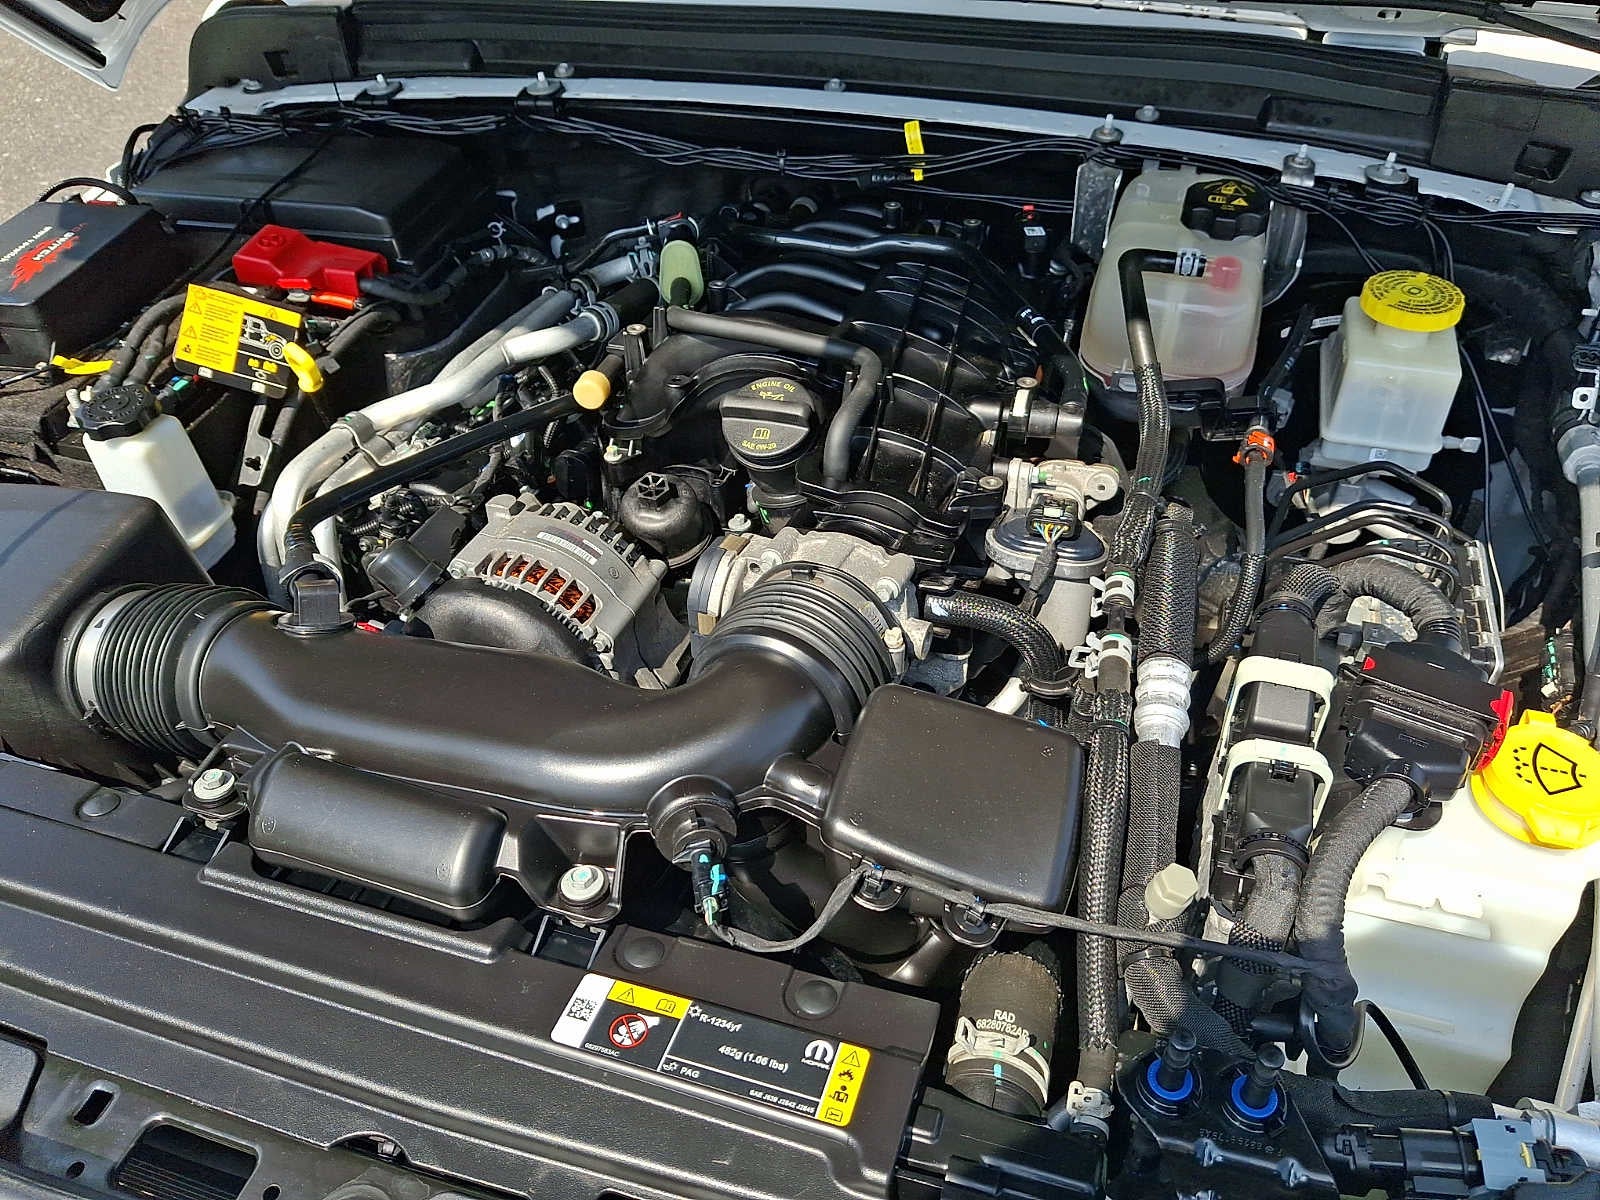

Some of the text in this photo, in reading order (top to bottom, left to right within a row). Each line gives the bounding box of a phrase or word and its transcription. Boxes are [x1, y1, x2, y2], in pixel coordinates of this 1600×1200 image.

[750, 381, 796, 393] ENGINE OIL
[741, 440, 777, 451] SAE 0W-20
[699, 1013, 744, 1032] R-1234yf
[993, 1009, 1016, 1024] RAD
[743, 1051, 768, 1066] (1.06
[769, 1058, 789, 1074] lbs)
[679, 1066, 700, 1079] PAG
